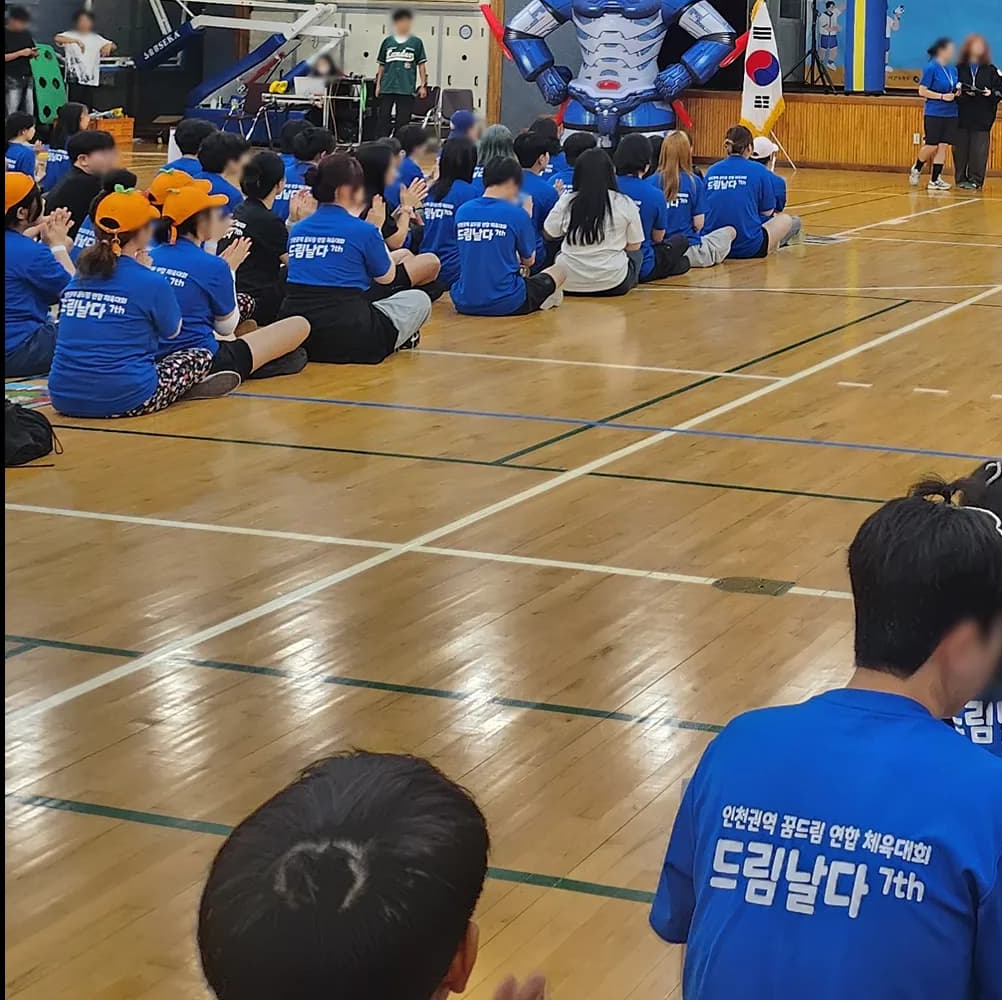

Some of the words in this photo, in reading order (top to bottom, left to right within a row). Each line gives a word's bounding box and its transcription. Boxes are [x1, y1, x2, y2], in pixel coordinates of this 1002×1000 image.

[456, 227, 494, 242] 드림날다
[169, 276, 185, 288] 7th
[109, 304, 126, 315] 7th
[722, 805, 778, 836] 인천권역
[780, 814, 826, 844] 꿈드림
[829, 824, 861, 851] 연합
[862, 829, 933, 865] 체육대회
[709, 838, 870, 919] 드림날다
[878, 866, 925, 902] 7th
